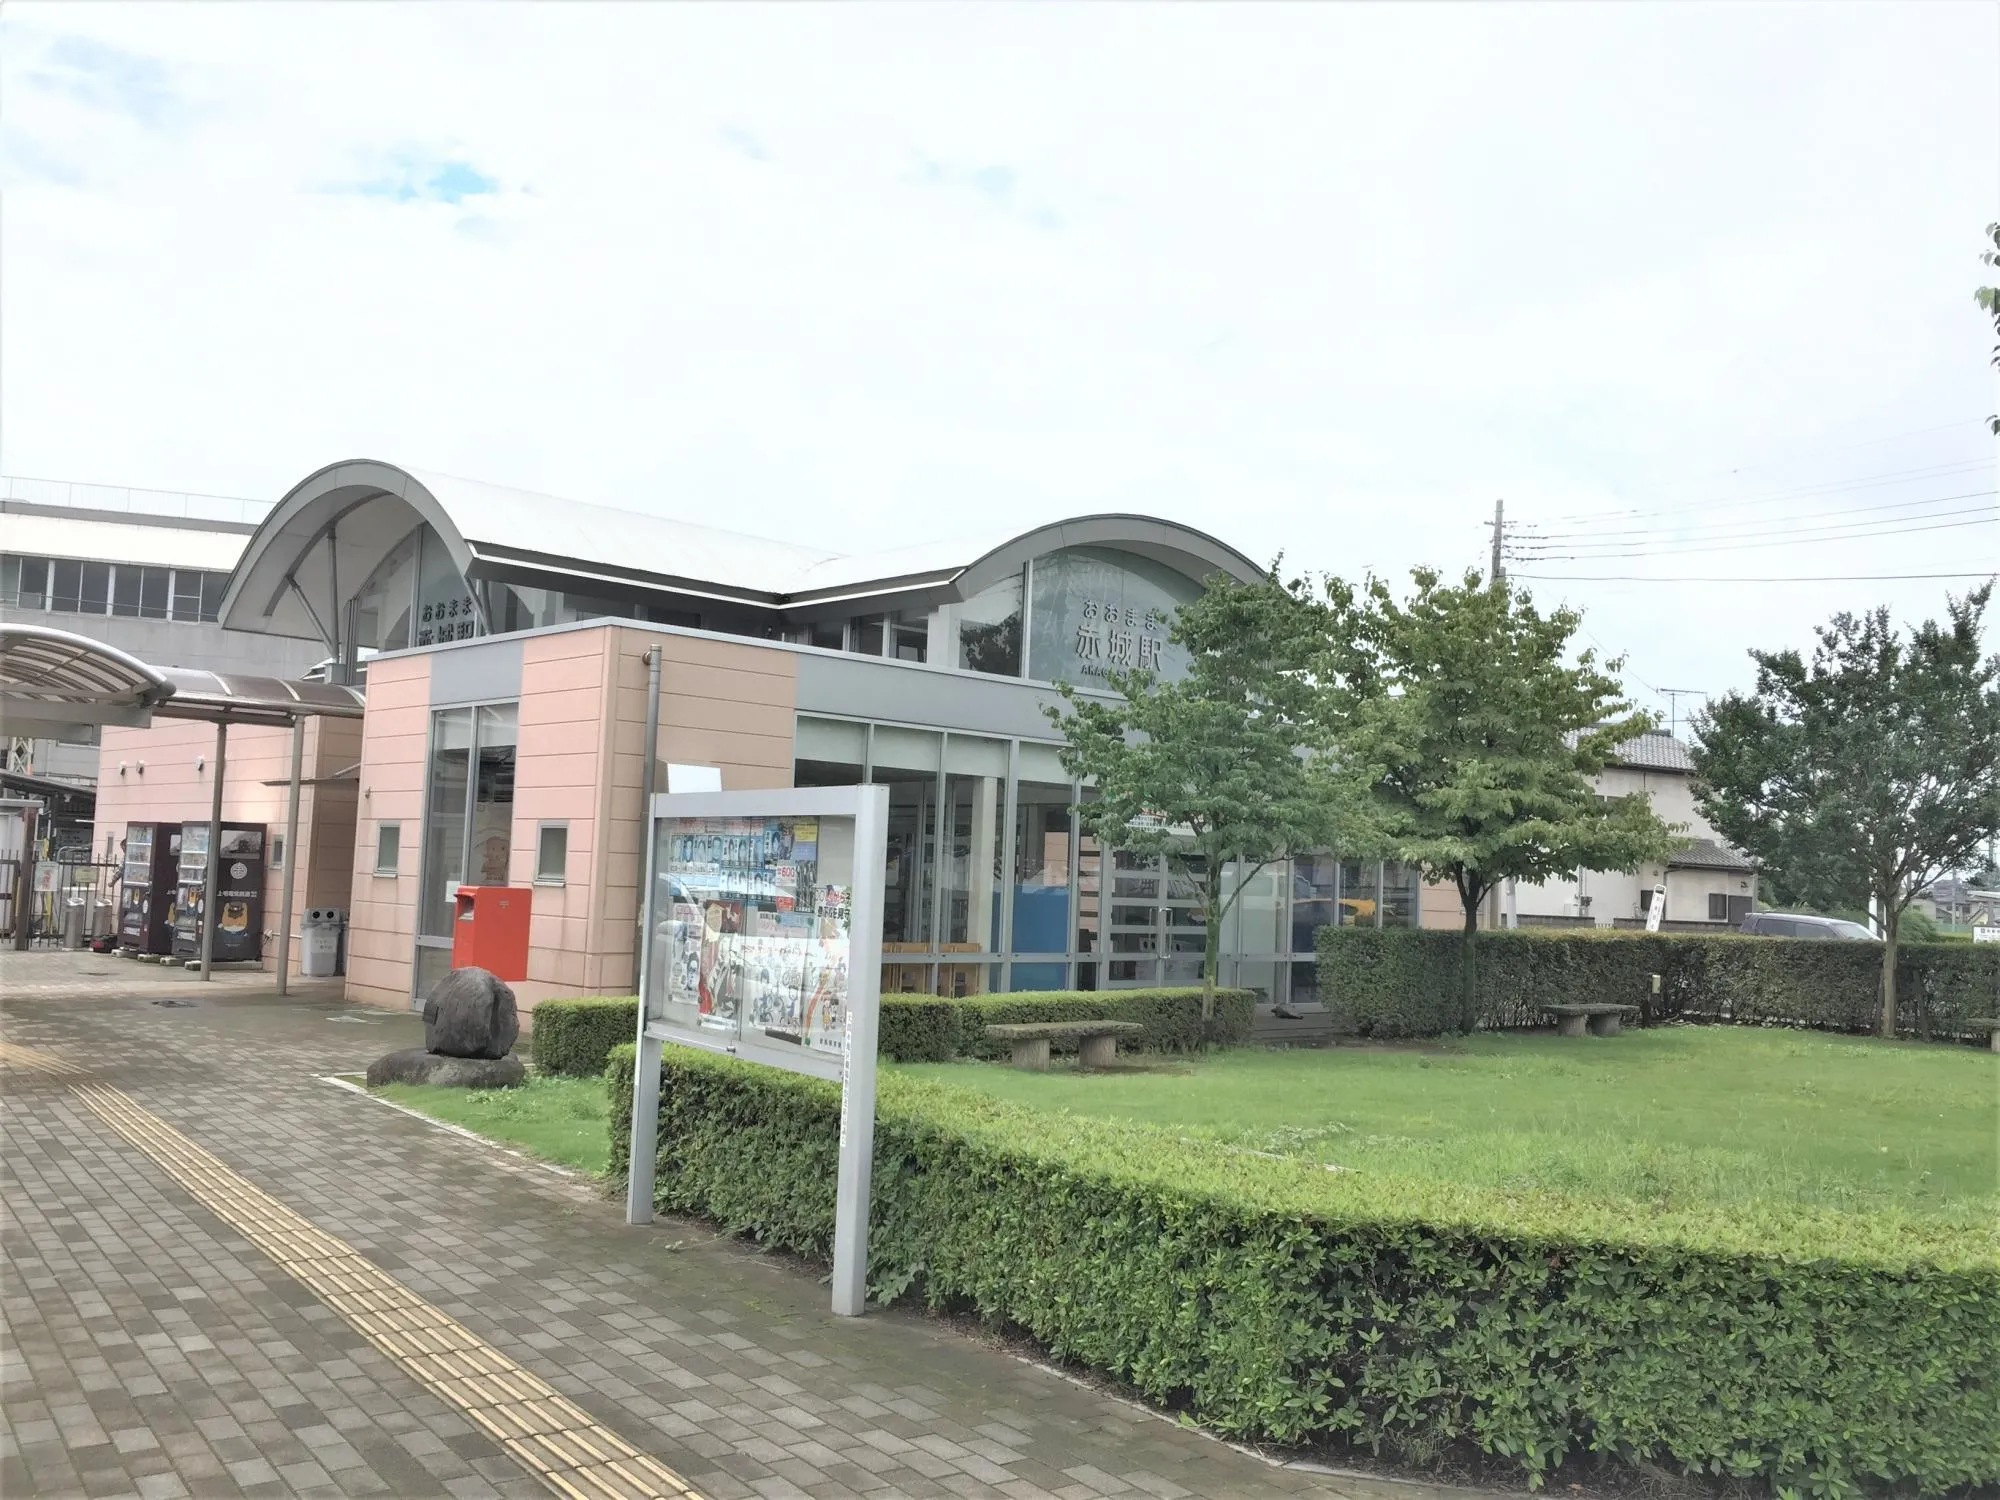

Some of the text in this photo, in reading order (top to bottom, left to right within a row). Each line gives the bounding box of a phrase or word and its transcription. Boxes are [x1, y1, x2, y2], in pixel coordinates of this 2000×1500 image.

[423, 596, 472, 622] おおまま
[1083, 599, 1158, 631] おおまま
[1075, 624, 1162, 672] 赤城駅
[1080, 664, 1110, 678] AKAG
